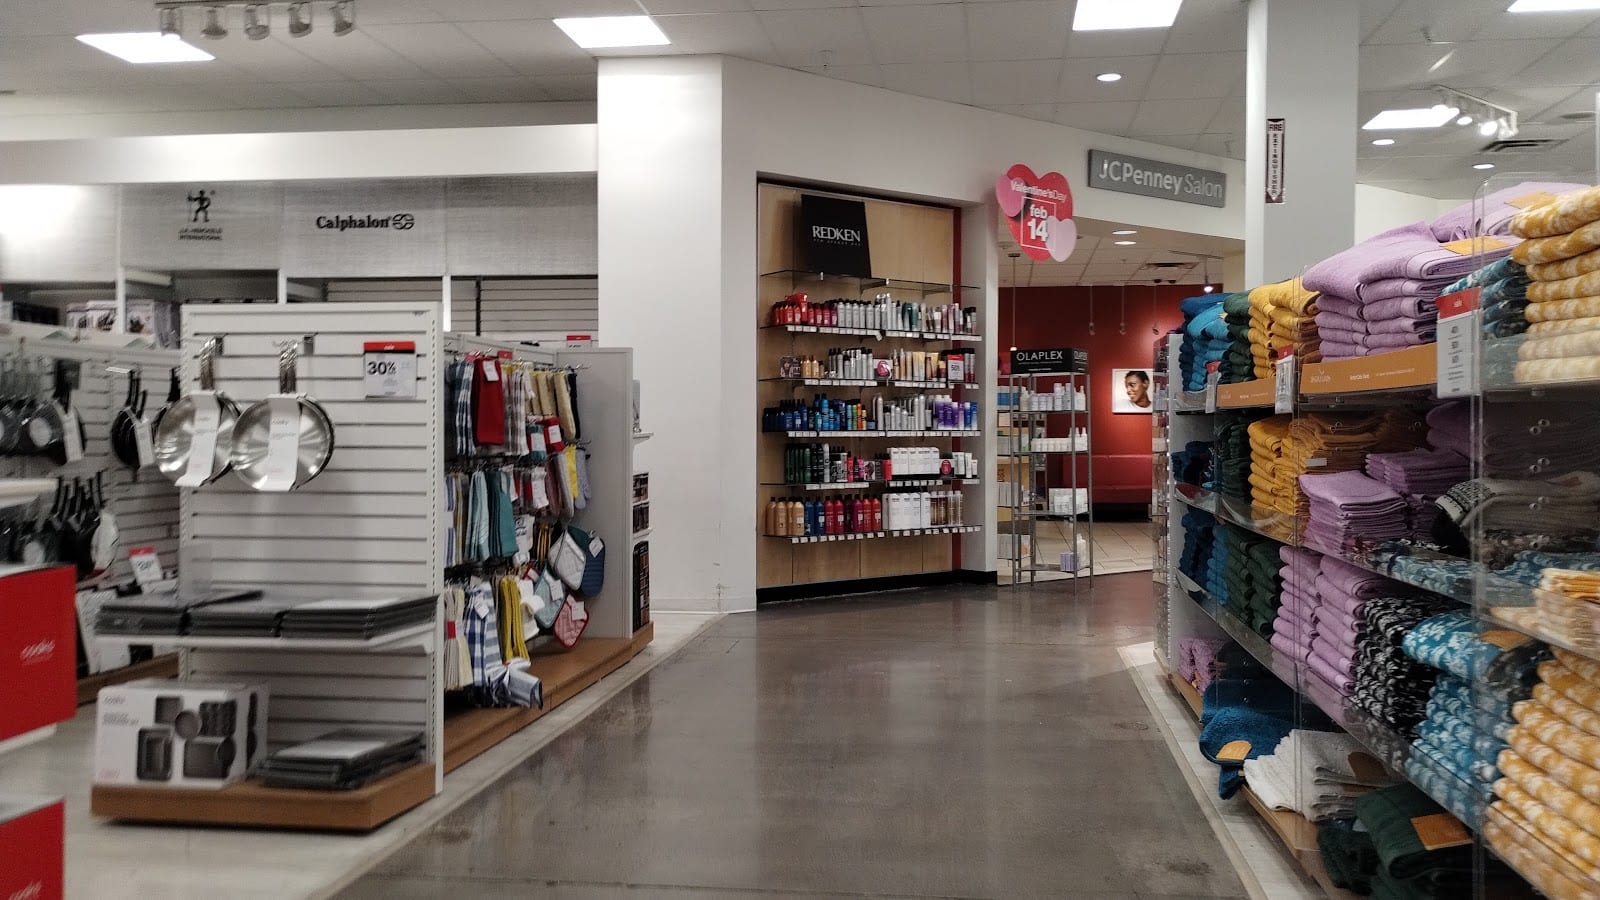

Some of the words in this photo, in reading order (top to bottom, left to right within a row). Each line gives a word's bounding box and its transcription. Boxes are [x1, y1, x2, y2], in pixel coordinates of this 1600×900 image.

[1269, 123, 1282, 131] FIRE
[1098, 160, 1182, 195] JCPenney
[1183, 173, 1222, 198] Salon
[1030, 204, 1048, 219] feb
[316, 214, 390, 231] Calphalon
[1027, 218, 1048, 241] 14
[812, 225, 860, 241] REDKEN
[1016, 350, 1063, 361] OLAPLEX
